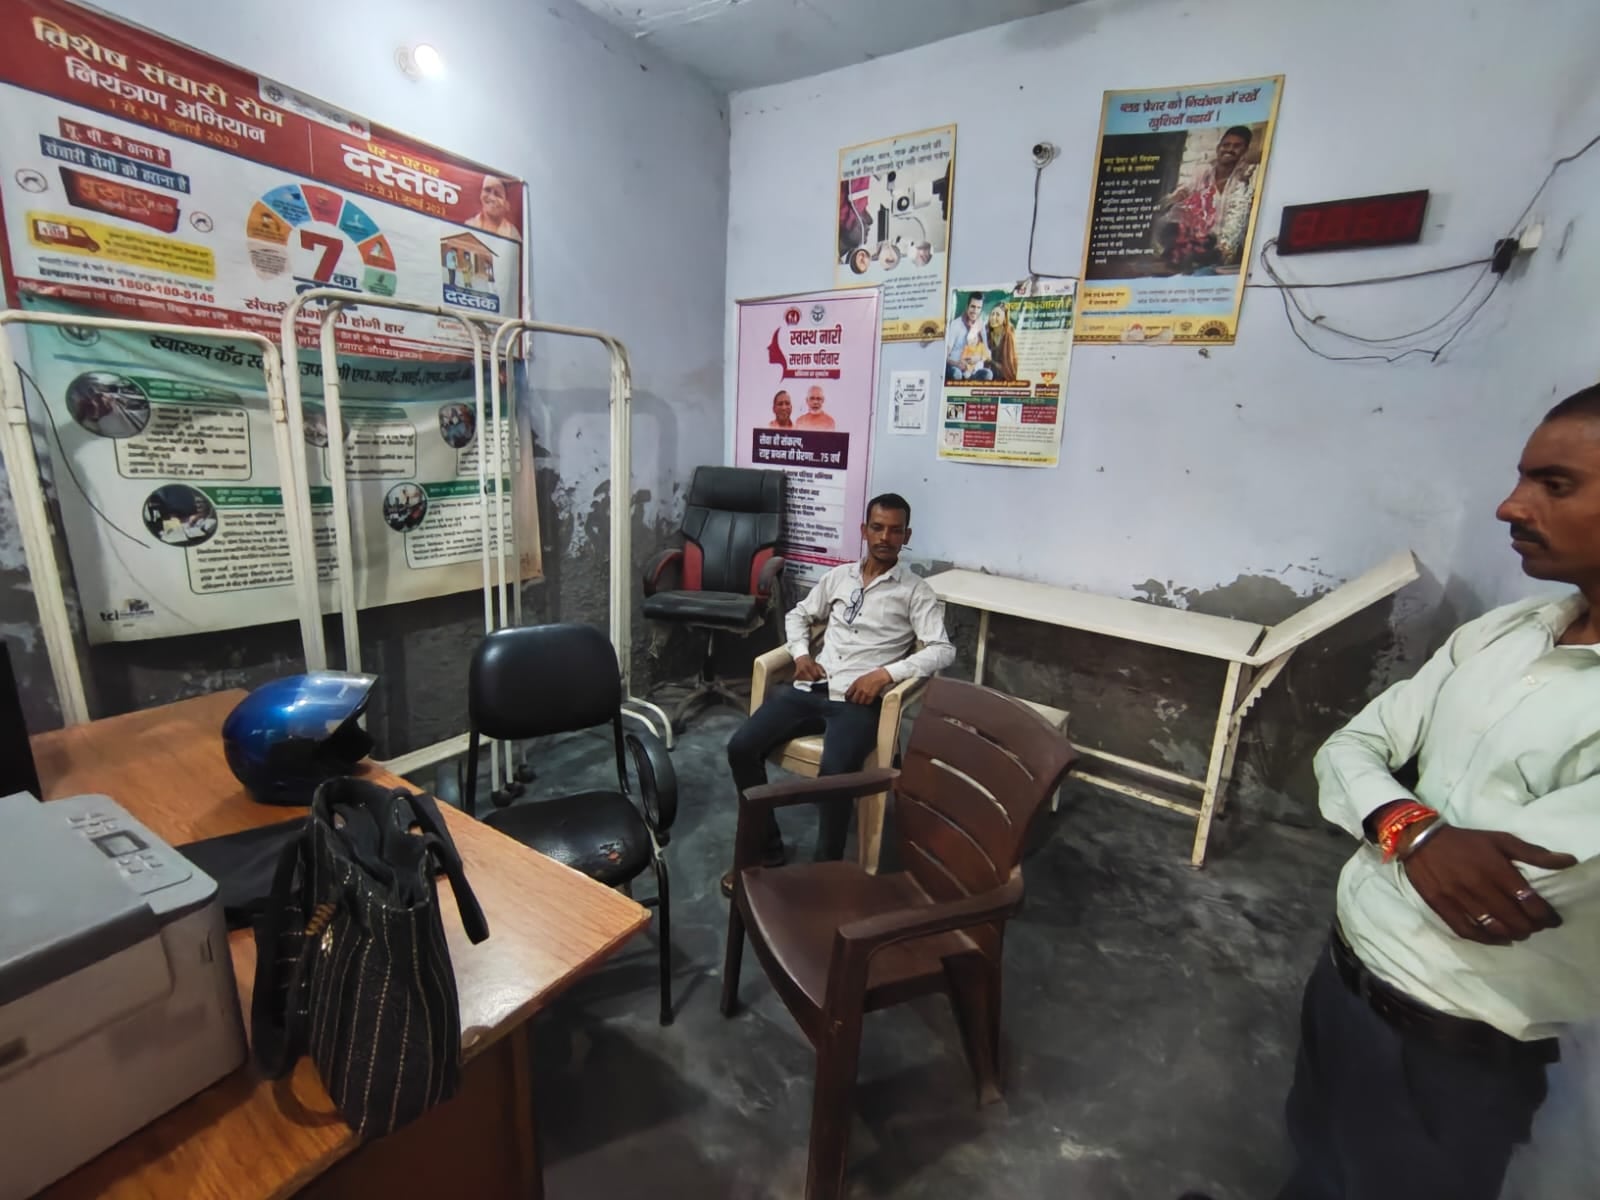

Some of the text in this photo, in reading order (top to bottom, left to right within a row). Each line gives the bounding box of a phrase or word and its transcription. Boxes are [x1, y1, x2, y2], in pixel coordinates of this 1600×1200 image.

[65, 55, 170, 111] नियंत्रण
[175, 98, 267, 144] अभियान
[136, 59, 229, 108] संचारी
[235, 95, 286, 128] रोग
[1143, 98, 1166, 112] प्रेशर
[1185, 94, 1224, 109] नियंत्रण
[90, 151, 119, 175] रोगों
[340, 143, 463, 206] दस्तक
[300, 229, 345, 284] 7
[332, 273, 359, 289] का
[117, 277, 216, 305] 1800-180-5145
[445, 289, 497, 310] दस्तक
[790, 324, 842, 345] स्वस्थ नारी
[789, 349, 840, 366] सशक्त परिवार
